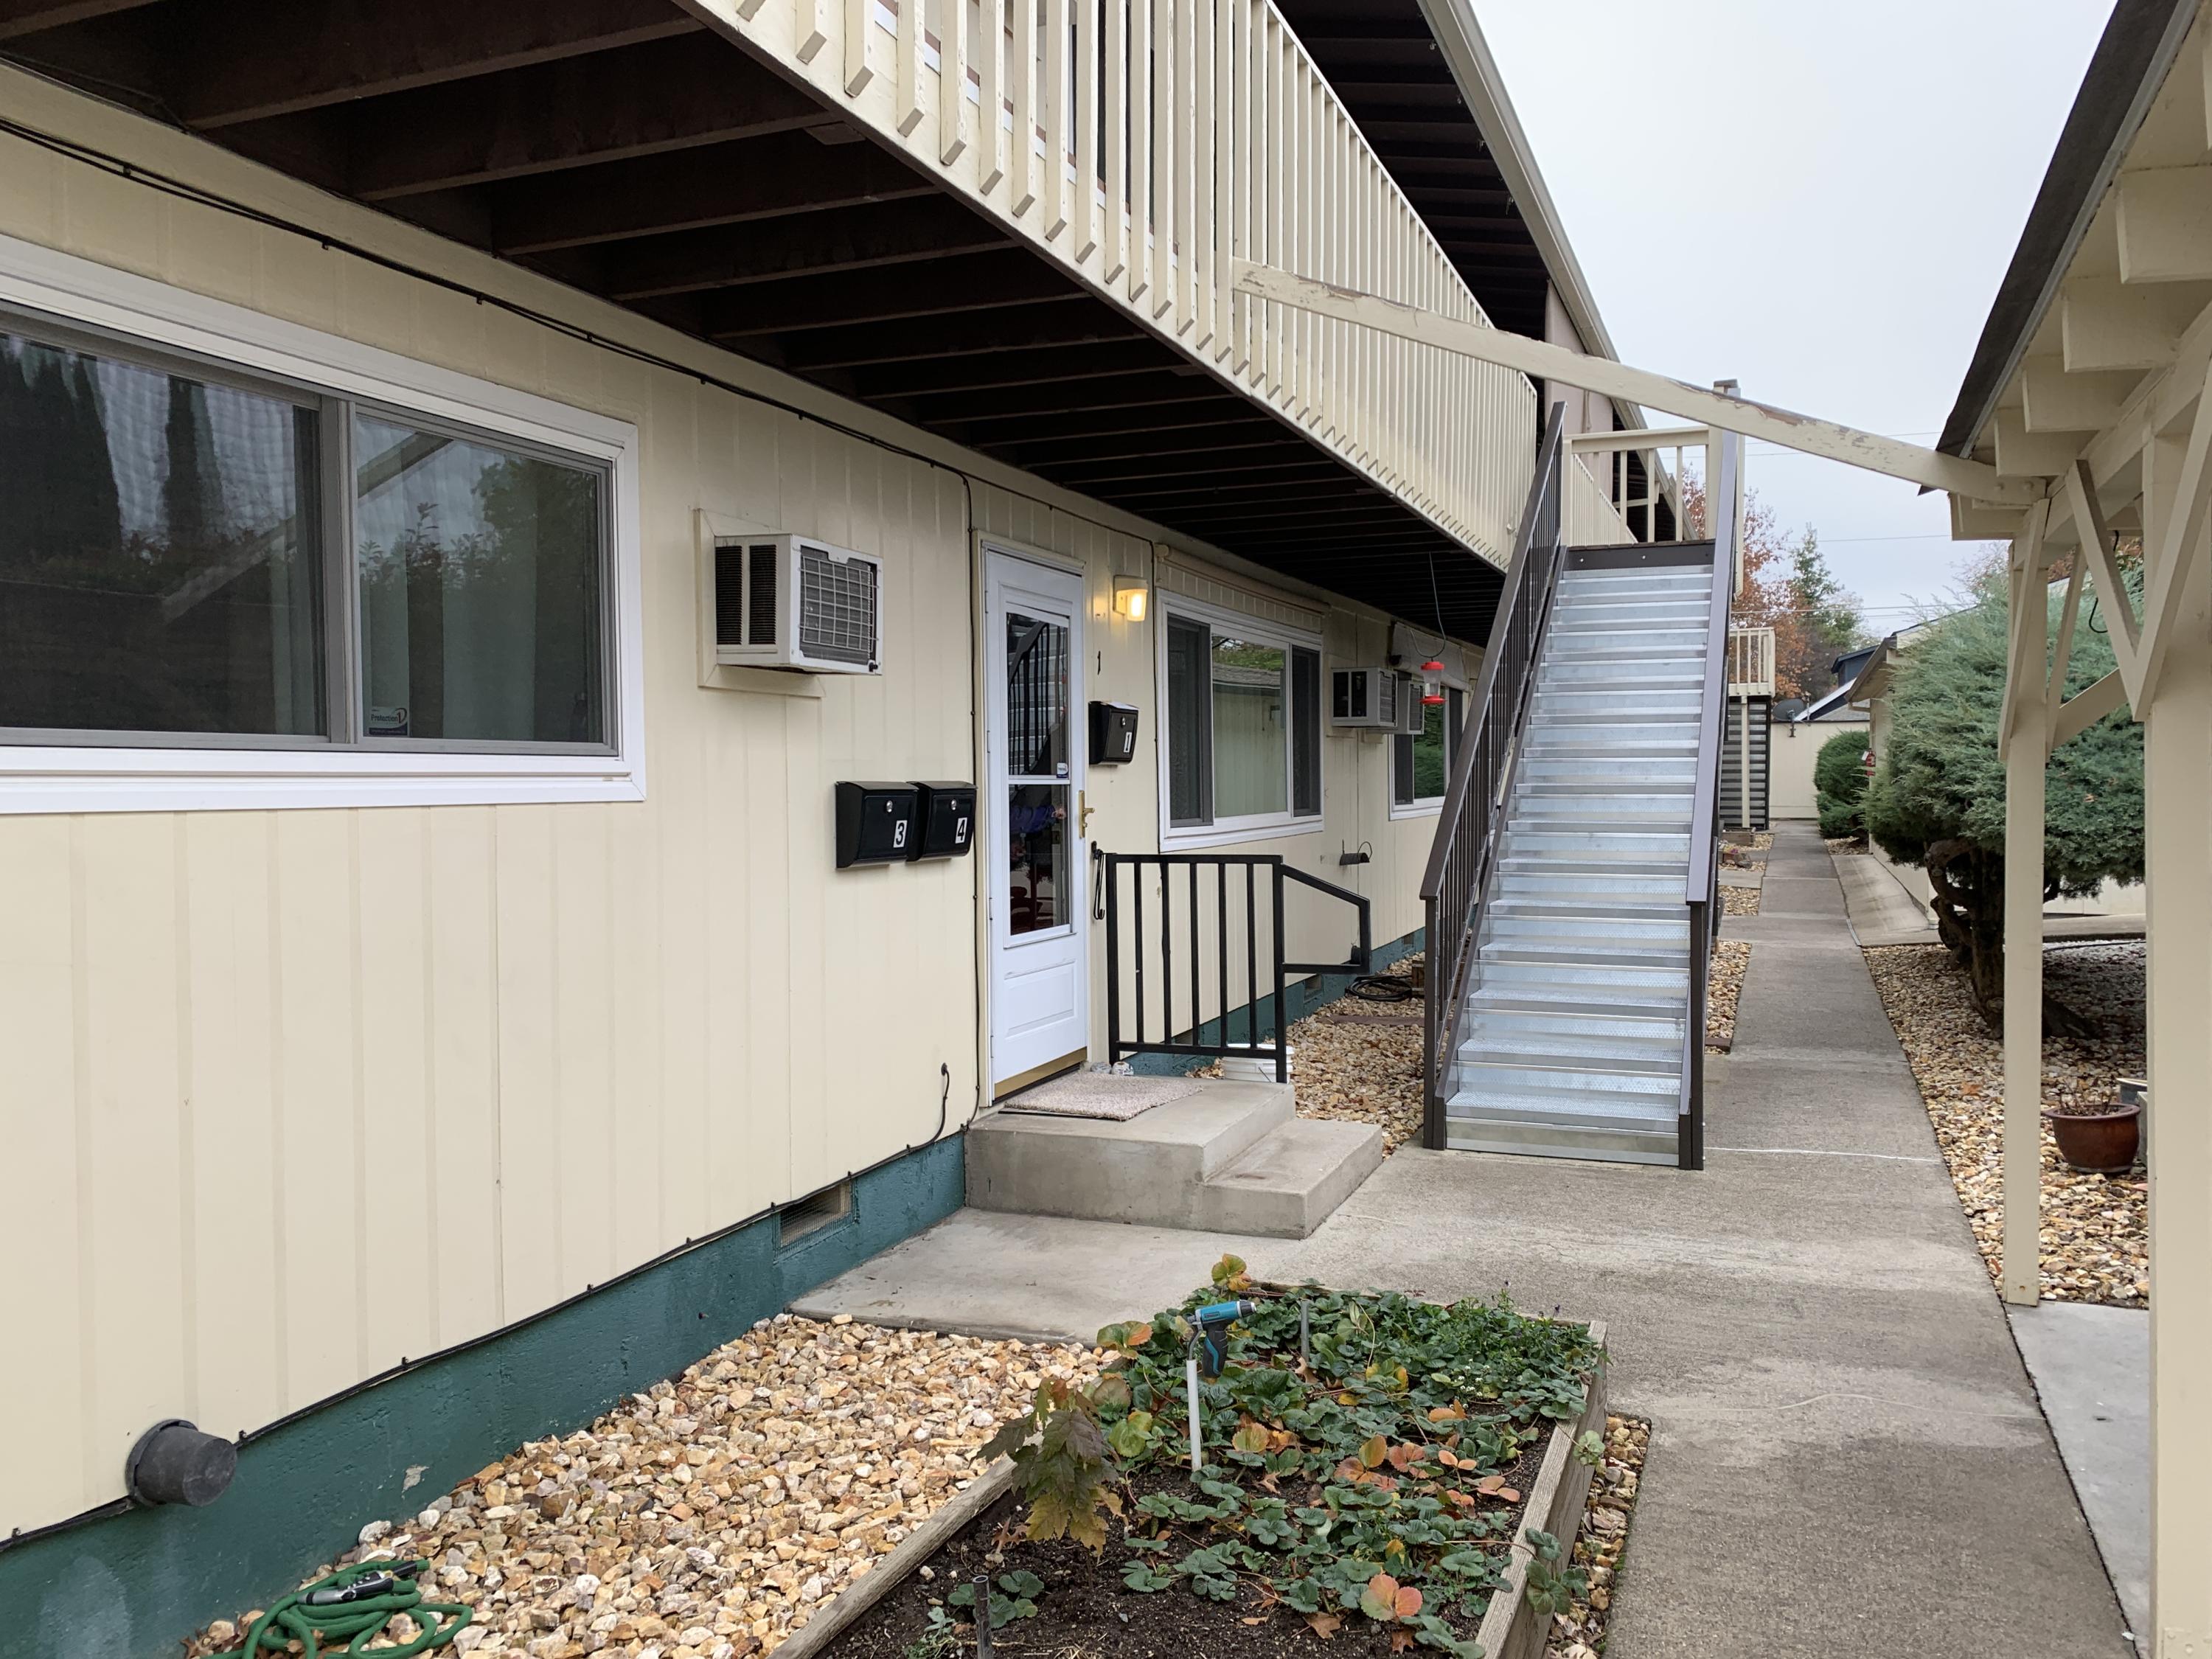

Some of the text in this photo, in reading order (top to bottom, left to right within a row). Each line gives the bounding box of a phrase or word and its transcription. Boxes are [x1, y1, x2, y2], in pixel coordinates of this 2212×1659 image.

[371, 714, 398, 722] Protection
[896, 822, 905, 845] 3
[957, 819, 965, 841] 4
